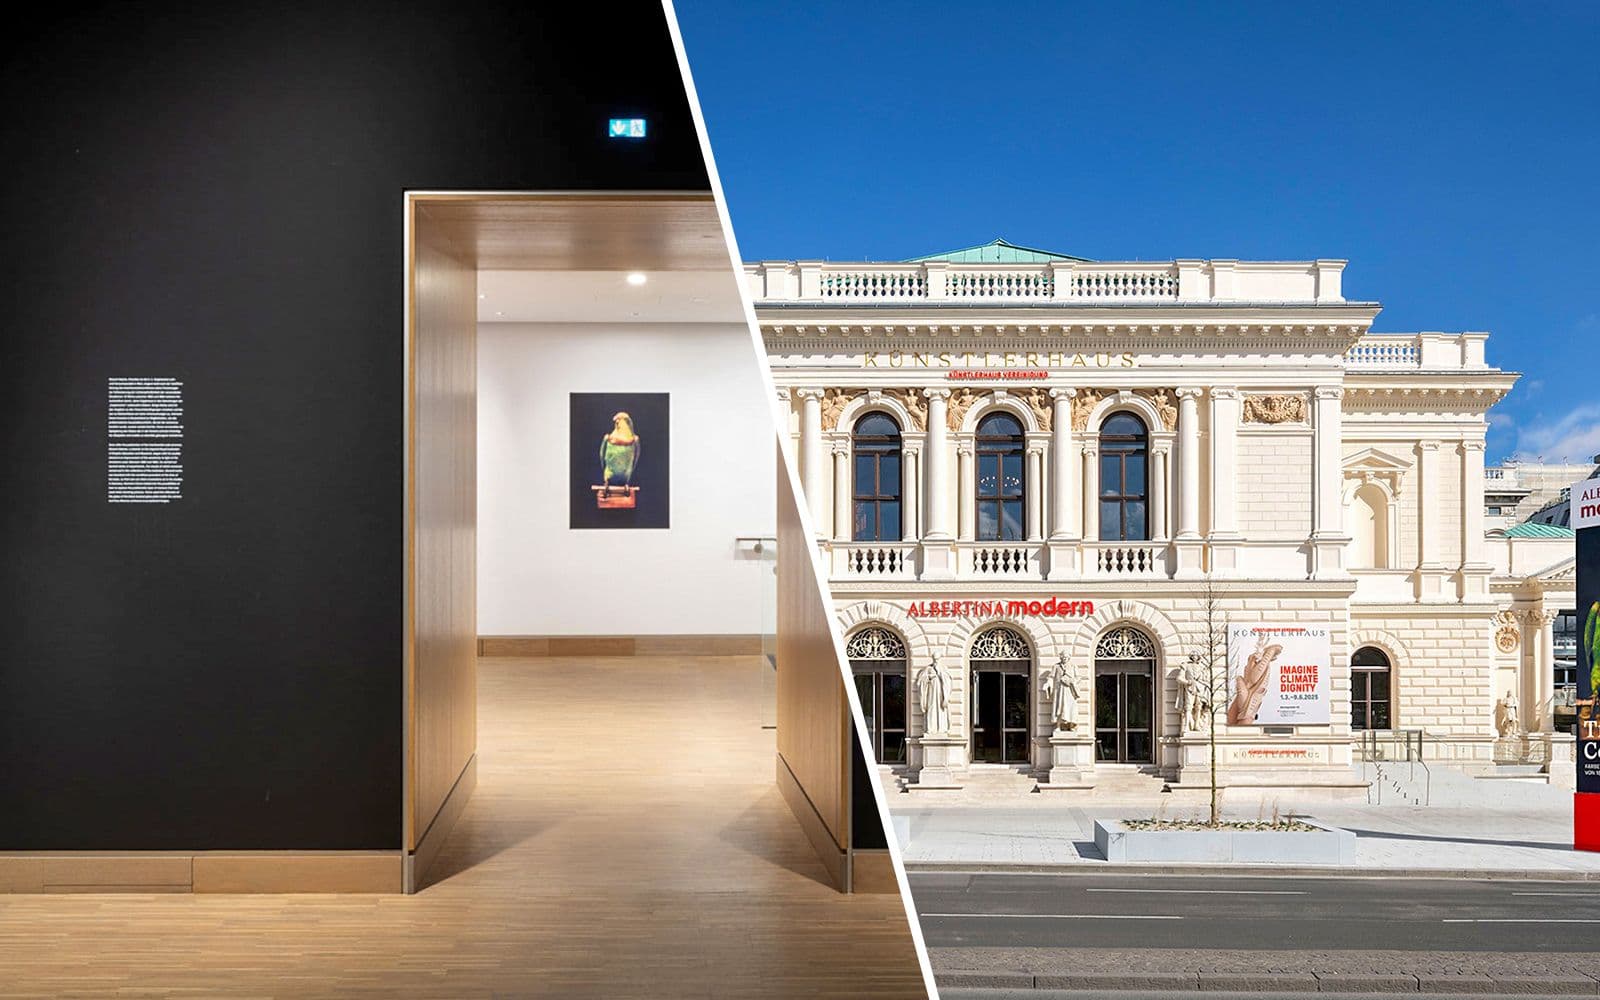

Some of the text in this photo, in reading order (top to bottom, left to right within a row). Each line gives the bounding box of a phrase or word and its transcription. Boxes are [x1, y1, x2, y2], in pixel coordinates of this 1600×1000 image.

[864, 350, 1134, 368] KÜNSTLERHAUS
[948, 370, 1001, 379] KÜNSTLERHAUS
[906, 597, 1094, 617] ALBERTINA modern
[1280, 665, 1318, 674] IMAGINE
[1280, 675, 1319, 683] CLIMATE
[1280, 684, 1316, 692] DIGNITY
[1583, 741, 1600, 760] C
